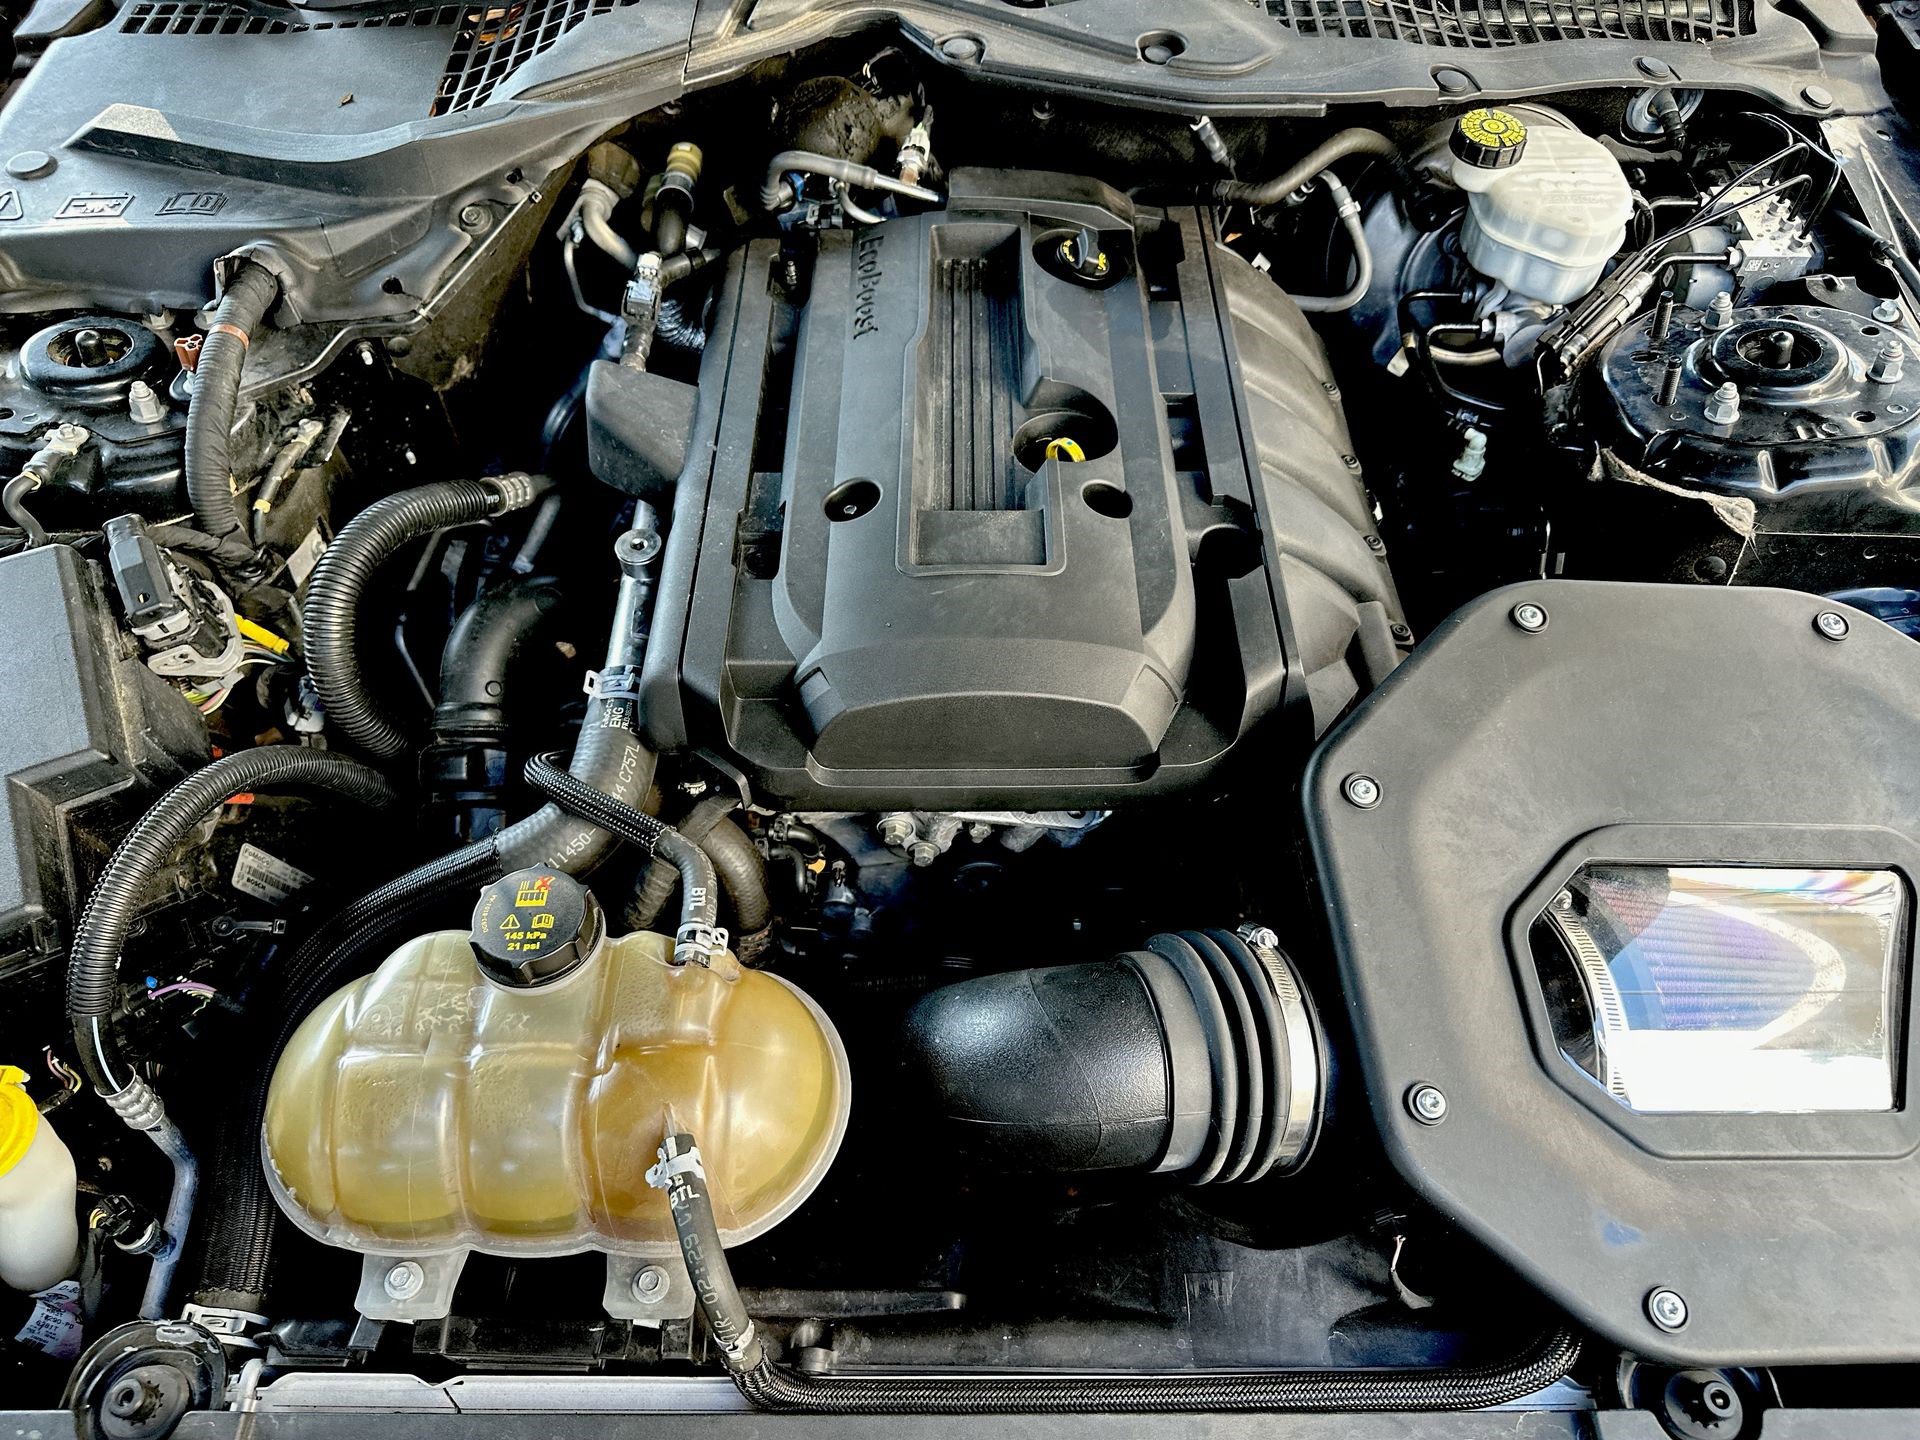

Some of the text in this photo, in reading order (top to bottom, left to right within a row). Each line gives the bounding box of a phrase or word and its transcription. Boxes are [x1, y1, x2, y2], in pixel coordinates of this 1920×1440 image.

[853, 235, 885, 341] EcoBoost
[608, 706, 625, 729] ENG
[618, 744, 641, 784] C757L
[246, 876, 267, 891] BOSCH
[688, 886, 707, 912] BTL
[503, 930, 548, 941] 145 kPa
[506, 941, 542, 952] 21 psi
[669, 1184, 701, 1210] BTL
